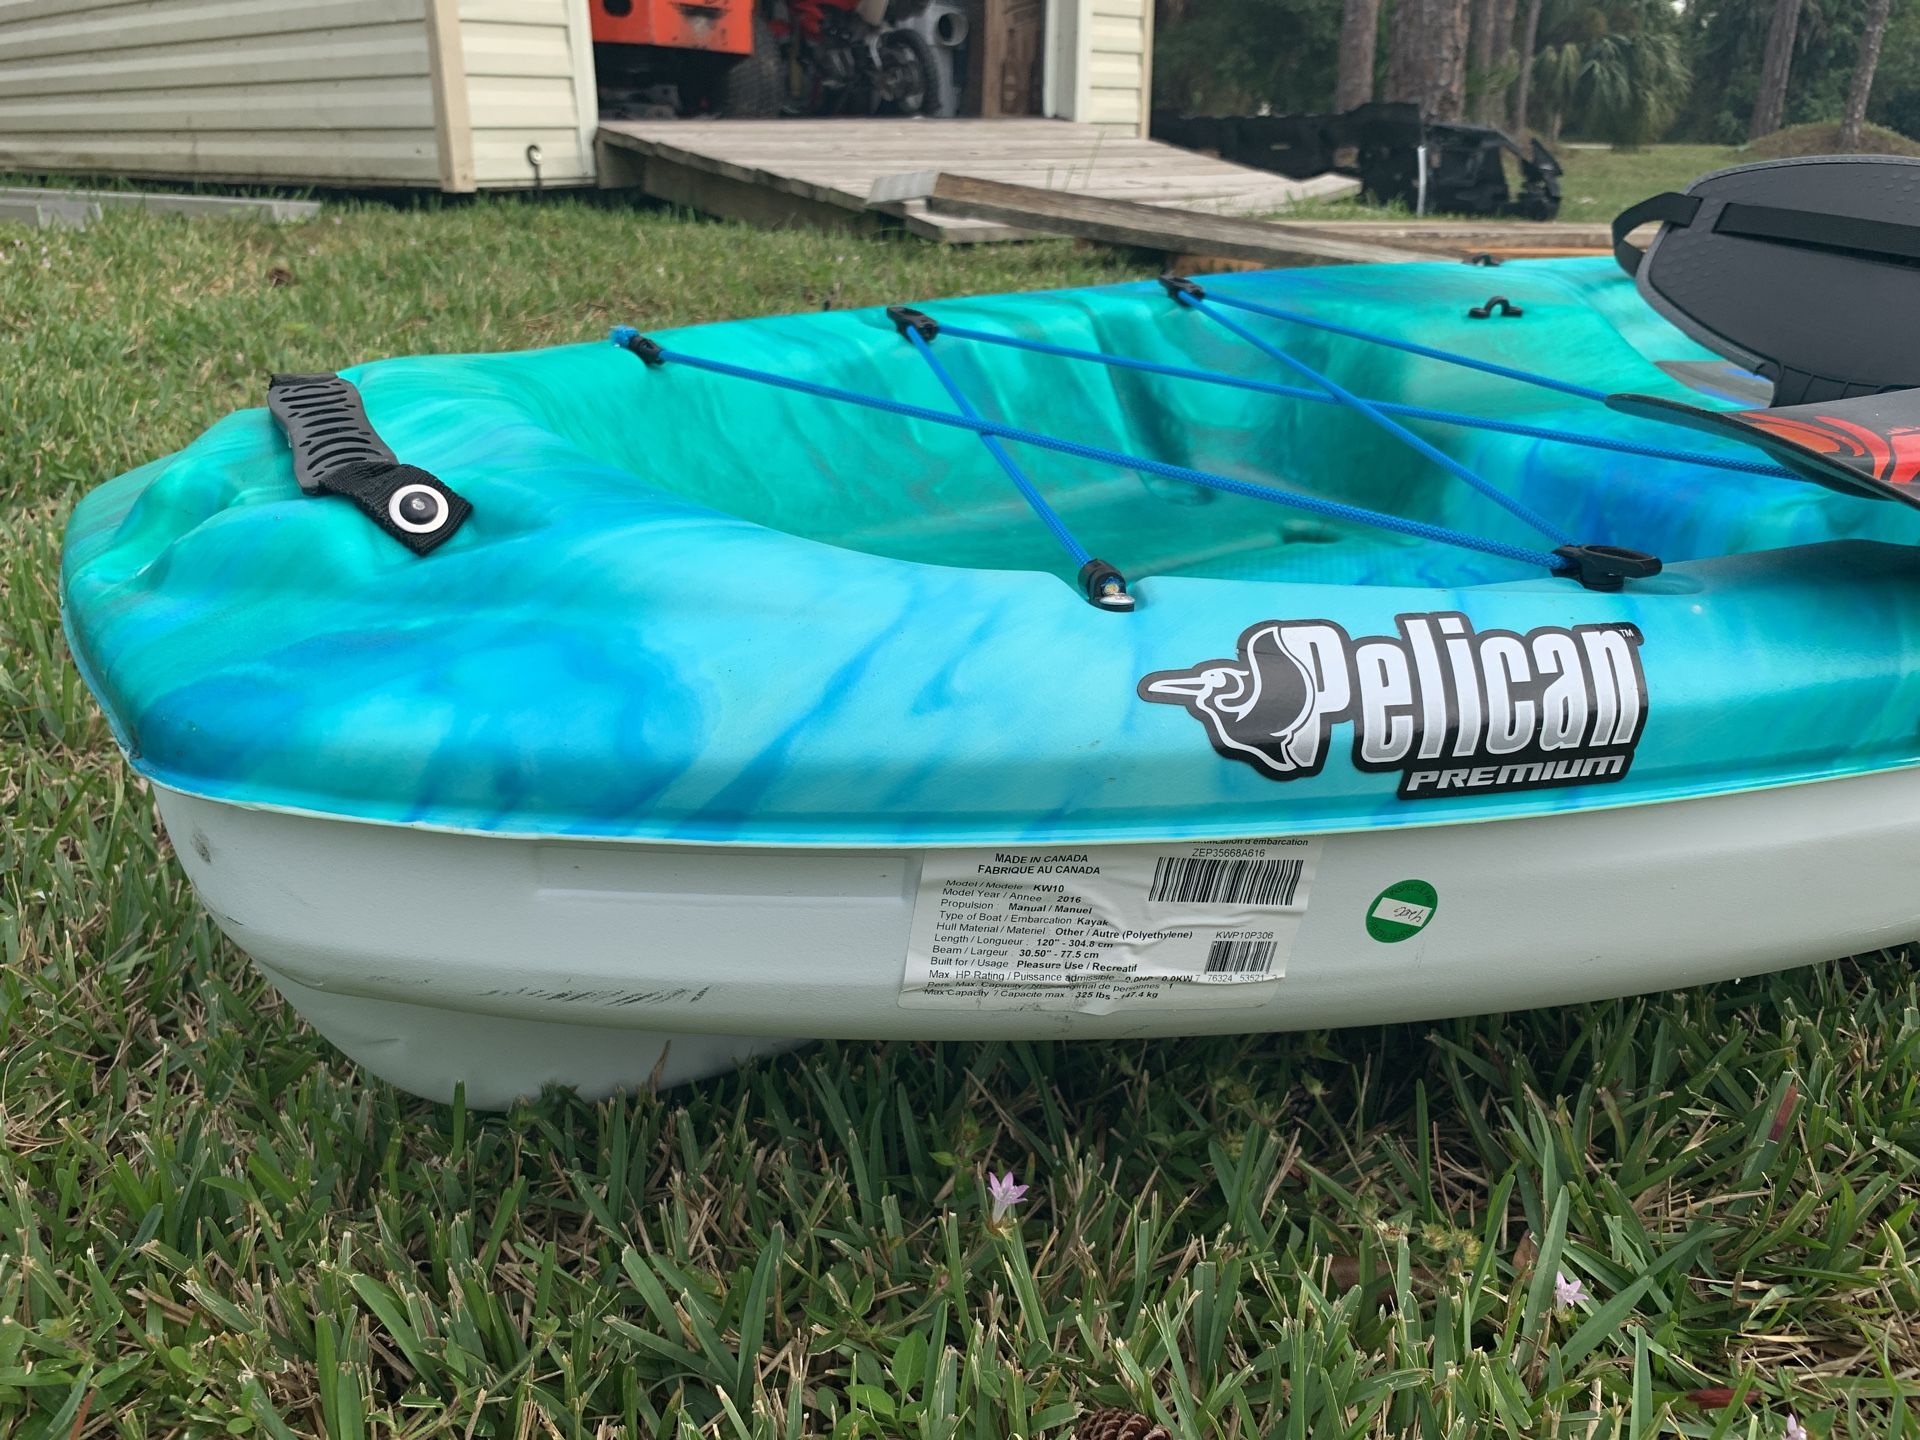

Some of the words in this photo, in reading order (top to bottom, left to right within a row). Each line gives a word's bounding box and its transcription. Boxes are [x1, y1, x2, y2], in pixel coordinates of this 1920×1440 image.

[1281, 617, 1640, 767] Pelican
[1406, 755, 1626, 792] PREMIUM
[995, 853, 1028, 864] MADE
[1030, 856, 1041, 864] IN
[1043, 854, 1089, 863] CANADA
[1192, 848, 1266, 858] ZEP35668A616
[978, 864, 1035, 875] FABRIQUE
[1037, 865, 1053, 874] AU
[1055, 866, 1101, 875] CANADA
[945, 879, 978, 887] Model
[1033, 884, 1065, 893] KW10
[943, 888, 975, 897] Model
[977, 889, 1000, 898] Year
[1009, 892, 1042, 902] Annee
[1057, 895, 1082, 904] 2016
[941, 898, 994, 909] Propulsion
[1008, 903, 1047, 912] Manual
[1054, 905, 1093, 915] Manuel
[940, 910, 964, 921] Type
[966, 912, 978, 921] of
[979, 912, 1002, 922] Boat
[1011, 914, 1072, 924] Embarcation
[1077, 917, 1109, 928] Kayak
[936, 921, 957, 931] Hull
[959, 923, 999, 933] Material
[1006, 925, 1046, 935] Materiel
[1055, 927, 1085, 937] Other
[1092, 929, 1120, 939] Autre
[1122, 930, 1193, 941] (Polyethylene)
[1216, 931, 1274, 940] KWP10P306
[934, 933, 969, 944] Length
[977, 936, 1024, 947] Longueur
[1036, 938, 1060, 947] 120"
[1068, 939, 1096, 948] 304.8
[932, 945, 962, 954] Beam
[970, 947, 1009, 957] Largeur
[1019, 949, 1052, 958] 30.50"
[1060, 950, 1082, 959] 77.5
[930, 956, 953, 966] Built
[955, 957, 968, 967] for
[977, 959, 1009, 970] Usage
[1016, 960, 1062, 969] Pleasure
[1064, 961, 1084, 970] Use
[1092, 962, 1138, 972] Recreatif
[956, 970, 971, 979] HP
[973, 970, 1005, 981] Rating
[1013, 971, 1062, 981] Puissance
[1064, 974, 1115, 983] admissible
[1161, 975, 1193, 983] 0.0KW
[1207, 974, 1233, 983] 76324
[981, 981, 1023, 989] Capacity
[1113, 983, 1160, 993] personnes
[947, 989, 990, 998] Capacity
[1075, 991, 1094, 999] 325
[1096, 991, 1111, 1000] lbs
[1146, 991, 1159, 999] kg
